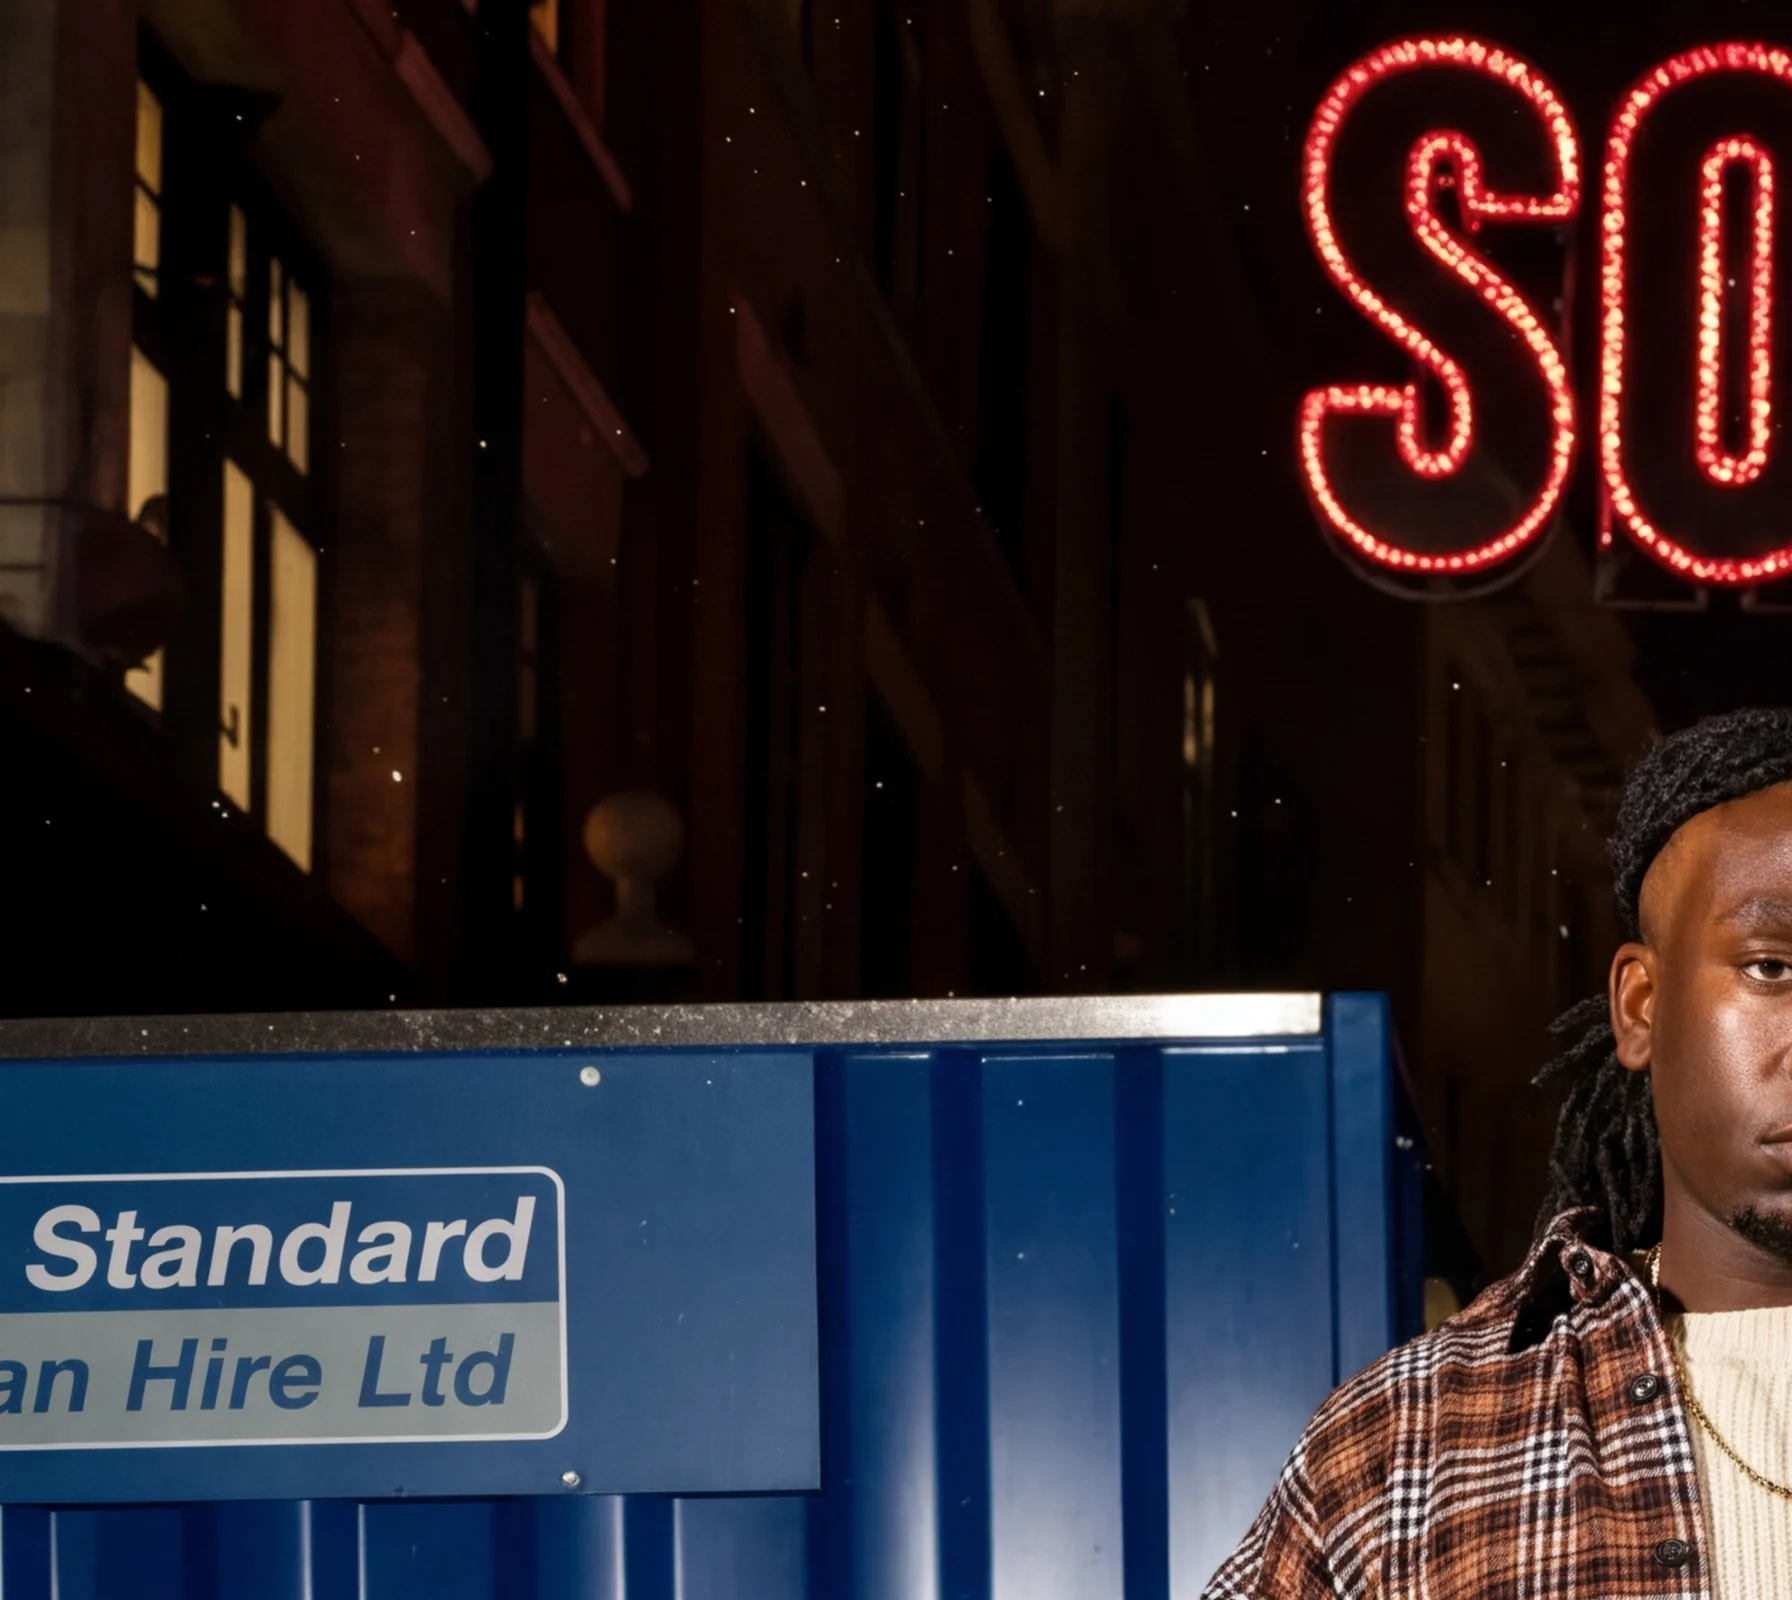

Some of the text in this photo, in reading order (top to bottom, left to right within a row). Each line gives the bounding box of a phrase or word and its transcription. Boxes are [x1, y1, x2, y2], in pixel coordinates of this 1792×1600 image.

[25, 1196, 536, 1291] Standard
[126, 1338, 322, 1411] Hire
[357, 1333, 515, 1408] Ltd
